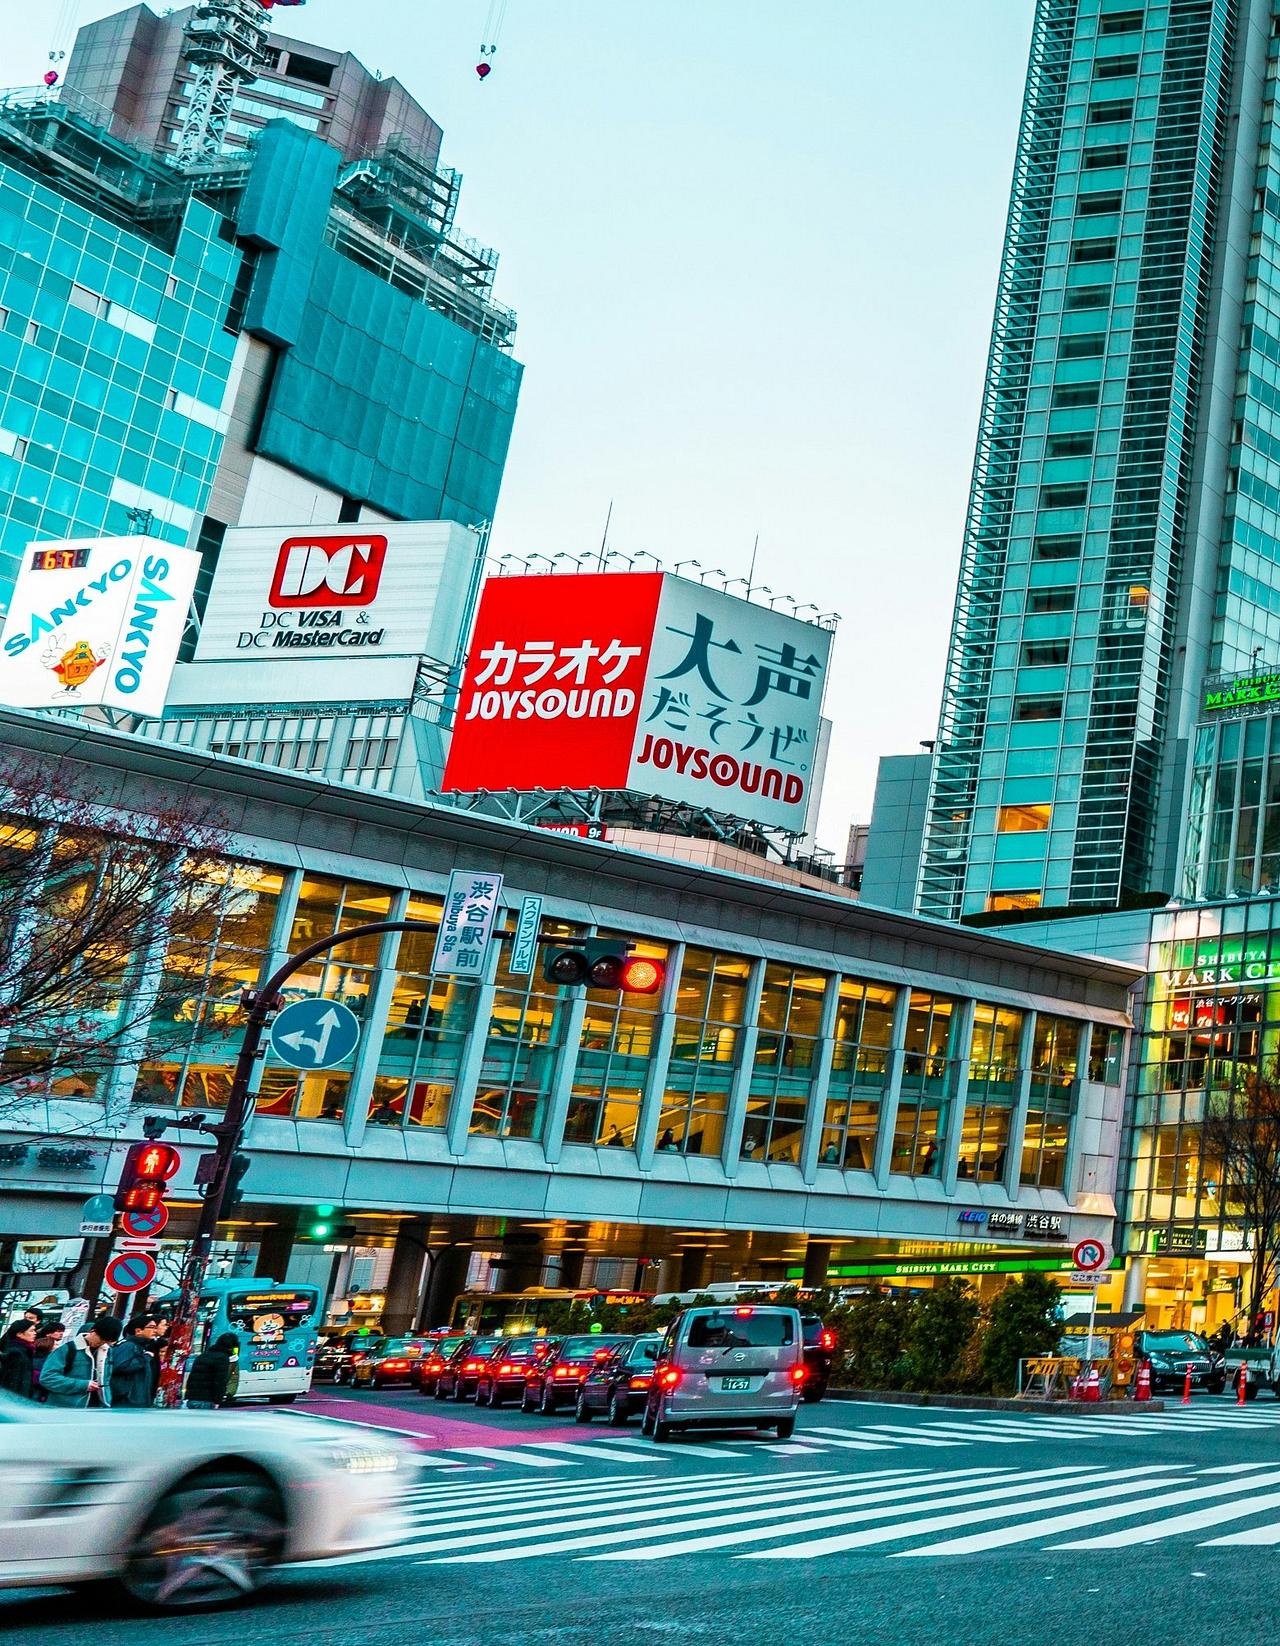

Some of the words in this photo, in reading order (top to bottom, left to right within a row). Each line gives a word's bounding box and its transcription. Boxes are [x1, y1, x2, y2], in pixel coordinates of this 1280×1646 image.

[279, 543, 372, 597] DC
[4, 559, 132, 657] SANKYO
[115, 555, 176, 694] SANKYO
[260, 611, 293, 629] DC
[298, 610, 344, 627] VISA
[355, 611, 370, 624] &
[236, 631, 268, 649] DC
[272, 628, 384, 649] MasterCard
[473, 638, 642, 687] カラオケ
[654, 612, 822, 707] 大声
[465, 688, 636, 721] JOYSOUND
[1206, 687, 1261, 705] MARK
[645, 686, 808, 772] だそうぜ。
[636, 734, 805, 804] JOYSOUND
[446, 891, 466, 932] Shibuya
[456, 881, 493, 968] 渋谷駅前
[442, 935, 457, 955] Sta.
[515, 900, 537, 970] スクランブル式
[1198, 950, 1267, 966] SHIBUYA
[1162, 968, 1233, 987] MARK
[958, 1209, 989, 1223] KEIO
[990, 1213, 1023, 1225] 井の頭線
[1026, 1215, 1062, 1230] 渋谷駅
[896, 1264, 937, 1273] SHIBUYA
[940, 1263, 969, 1272] MARK
[972, 1262, 996, 1271] CITY
[727, 1379, 749, 1390] 16-57
